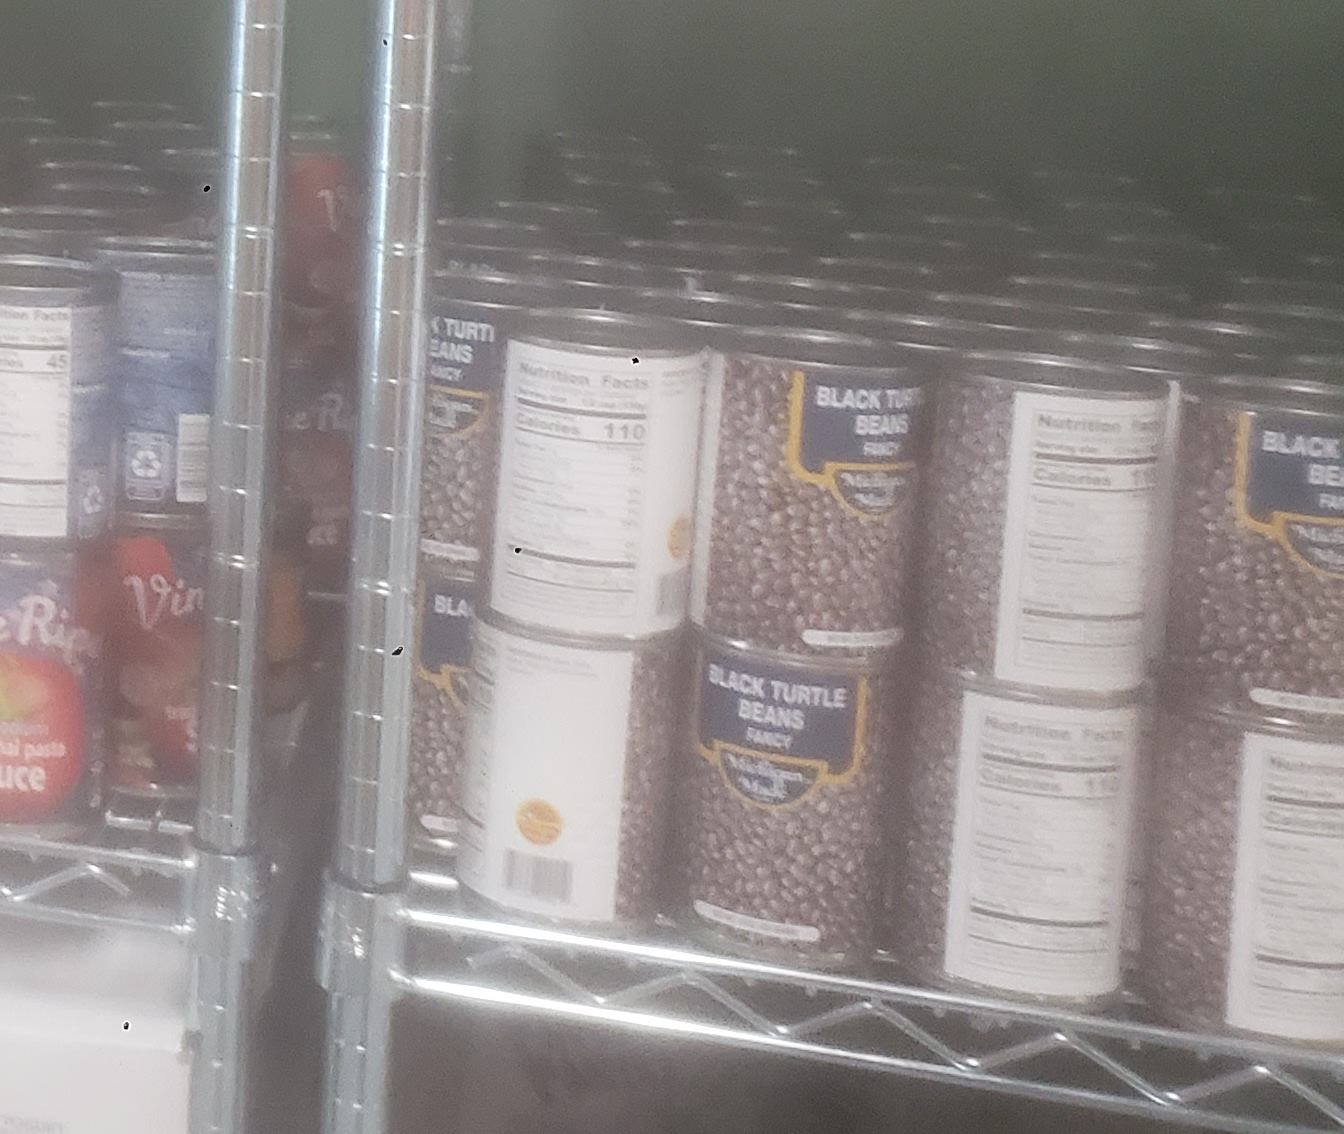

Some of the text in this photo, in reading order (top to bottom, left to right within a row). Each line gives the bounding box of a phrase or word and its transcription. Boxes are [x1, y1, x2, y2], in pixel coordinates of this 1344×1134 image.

[47, 353, 69, 370] 45
[519, 361, 650, 390] Nutrition Facts
[816, 385, 882, 410] BLACK
[605, 422, 646, 439] 110
[854, 413, 910, 437] BEANS
[1262, 430, 1341, 460] BLACK
[708, 662, 848, 709] BLACK TURTLE
[737, 698, 806, 731] BEANS
[746, 726, 792, 749] FANCY
